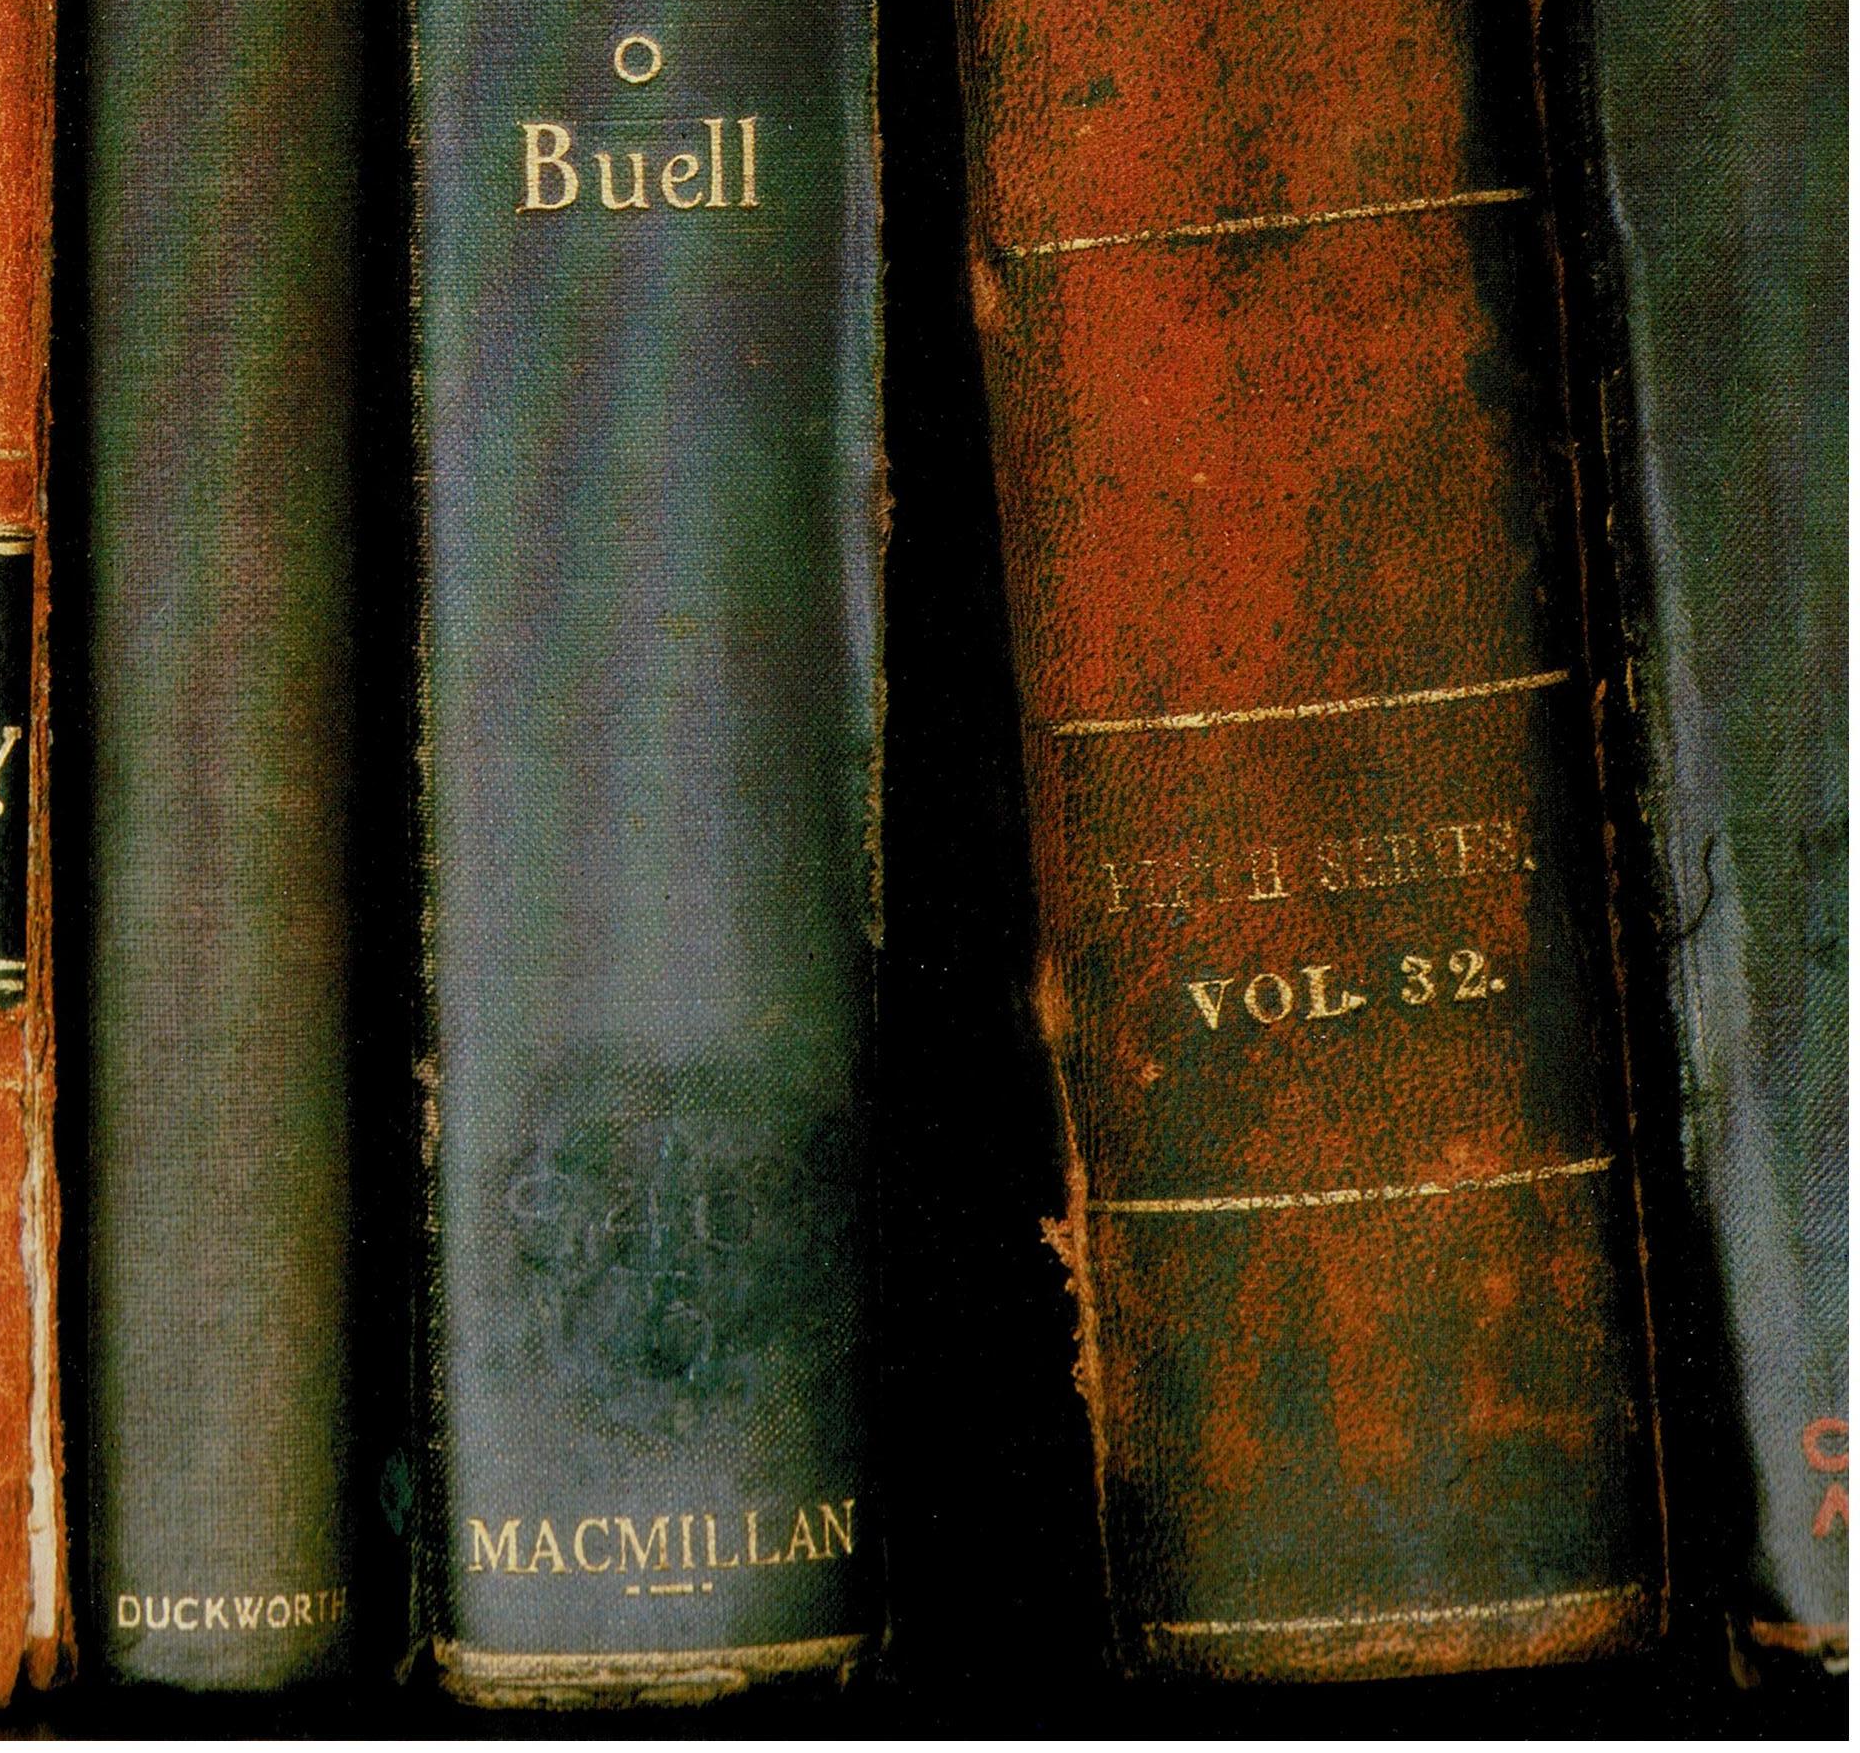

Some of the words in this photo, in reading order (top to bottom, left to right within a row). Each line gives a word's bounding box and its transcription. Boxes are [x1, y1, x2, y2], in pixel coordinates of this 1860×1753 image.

[517, 116, 760, 214] Buell
[1400, 949, 1507, 1006] 32.
[467, 1498, 855, 1575] MACMILLAN
[117, 1587, 347, 1630] DUCKWORTH
